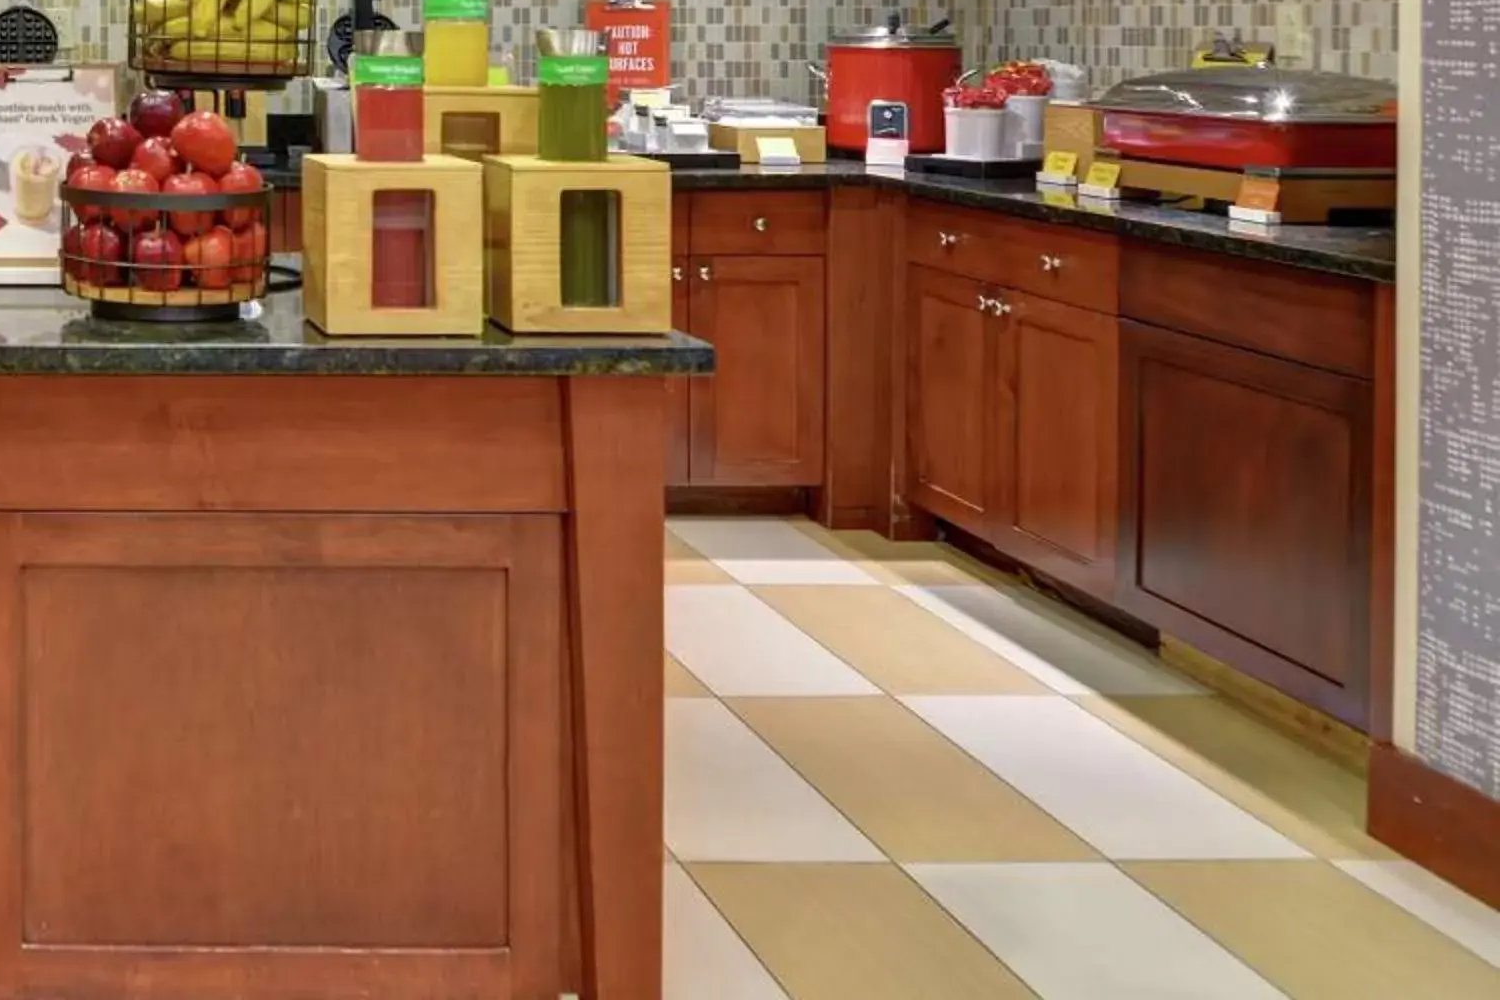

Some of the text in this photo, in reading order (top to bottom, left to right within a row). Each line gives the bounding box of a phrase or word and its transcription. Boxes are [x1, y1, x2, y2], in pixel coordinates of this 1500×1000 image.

[618, 41, 639, 55] HOT
[609, 57, 655, 71] URFACES
[37, 104, 66, 113] made
[69, 104, 93, 113] with
[25, 114, 58, 124] Greek
